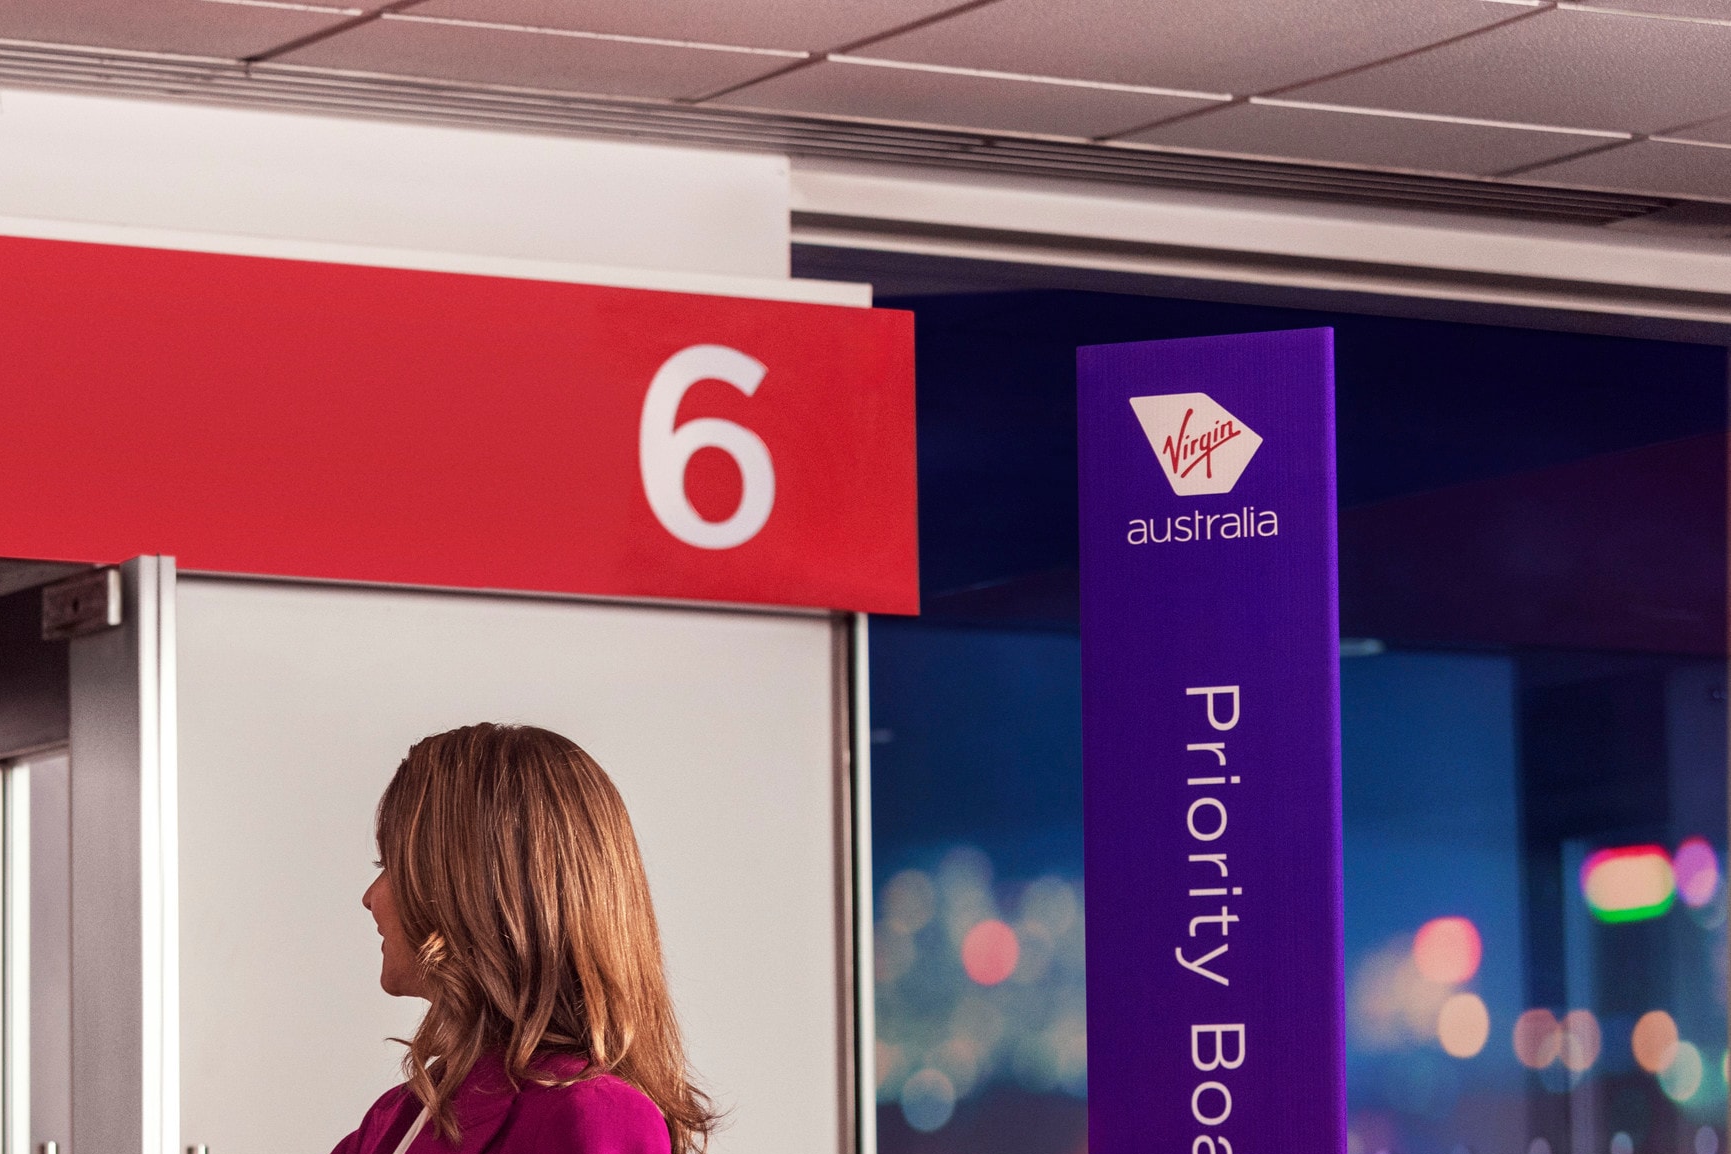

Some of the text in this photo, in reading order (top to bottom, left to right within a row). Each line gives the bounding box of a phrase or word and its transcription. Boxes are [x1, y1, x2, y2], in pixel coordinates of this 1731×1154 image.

[639, 345, 775, 549] 6
[1163, 408, 1241, 479] Virgin
[1127, 506, 1278, 545] australia
[1175, 685, 1243, 986] Priority
